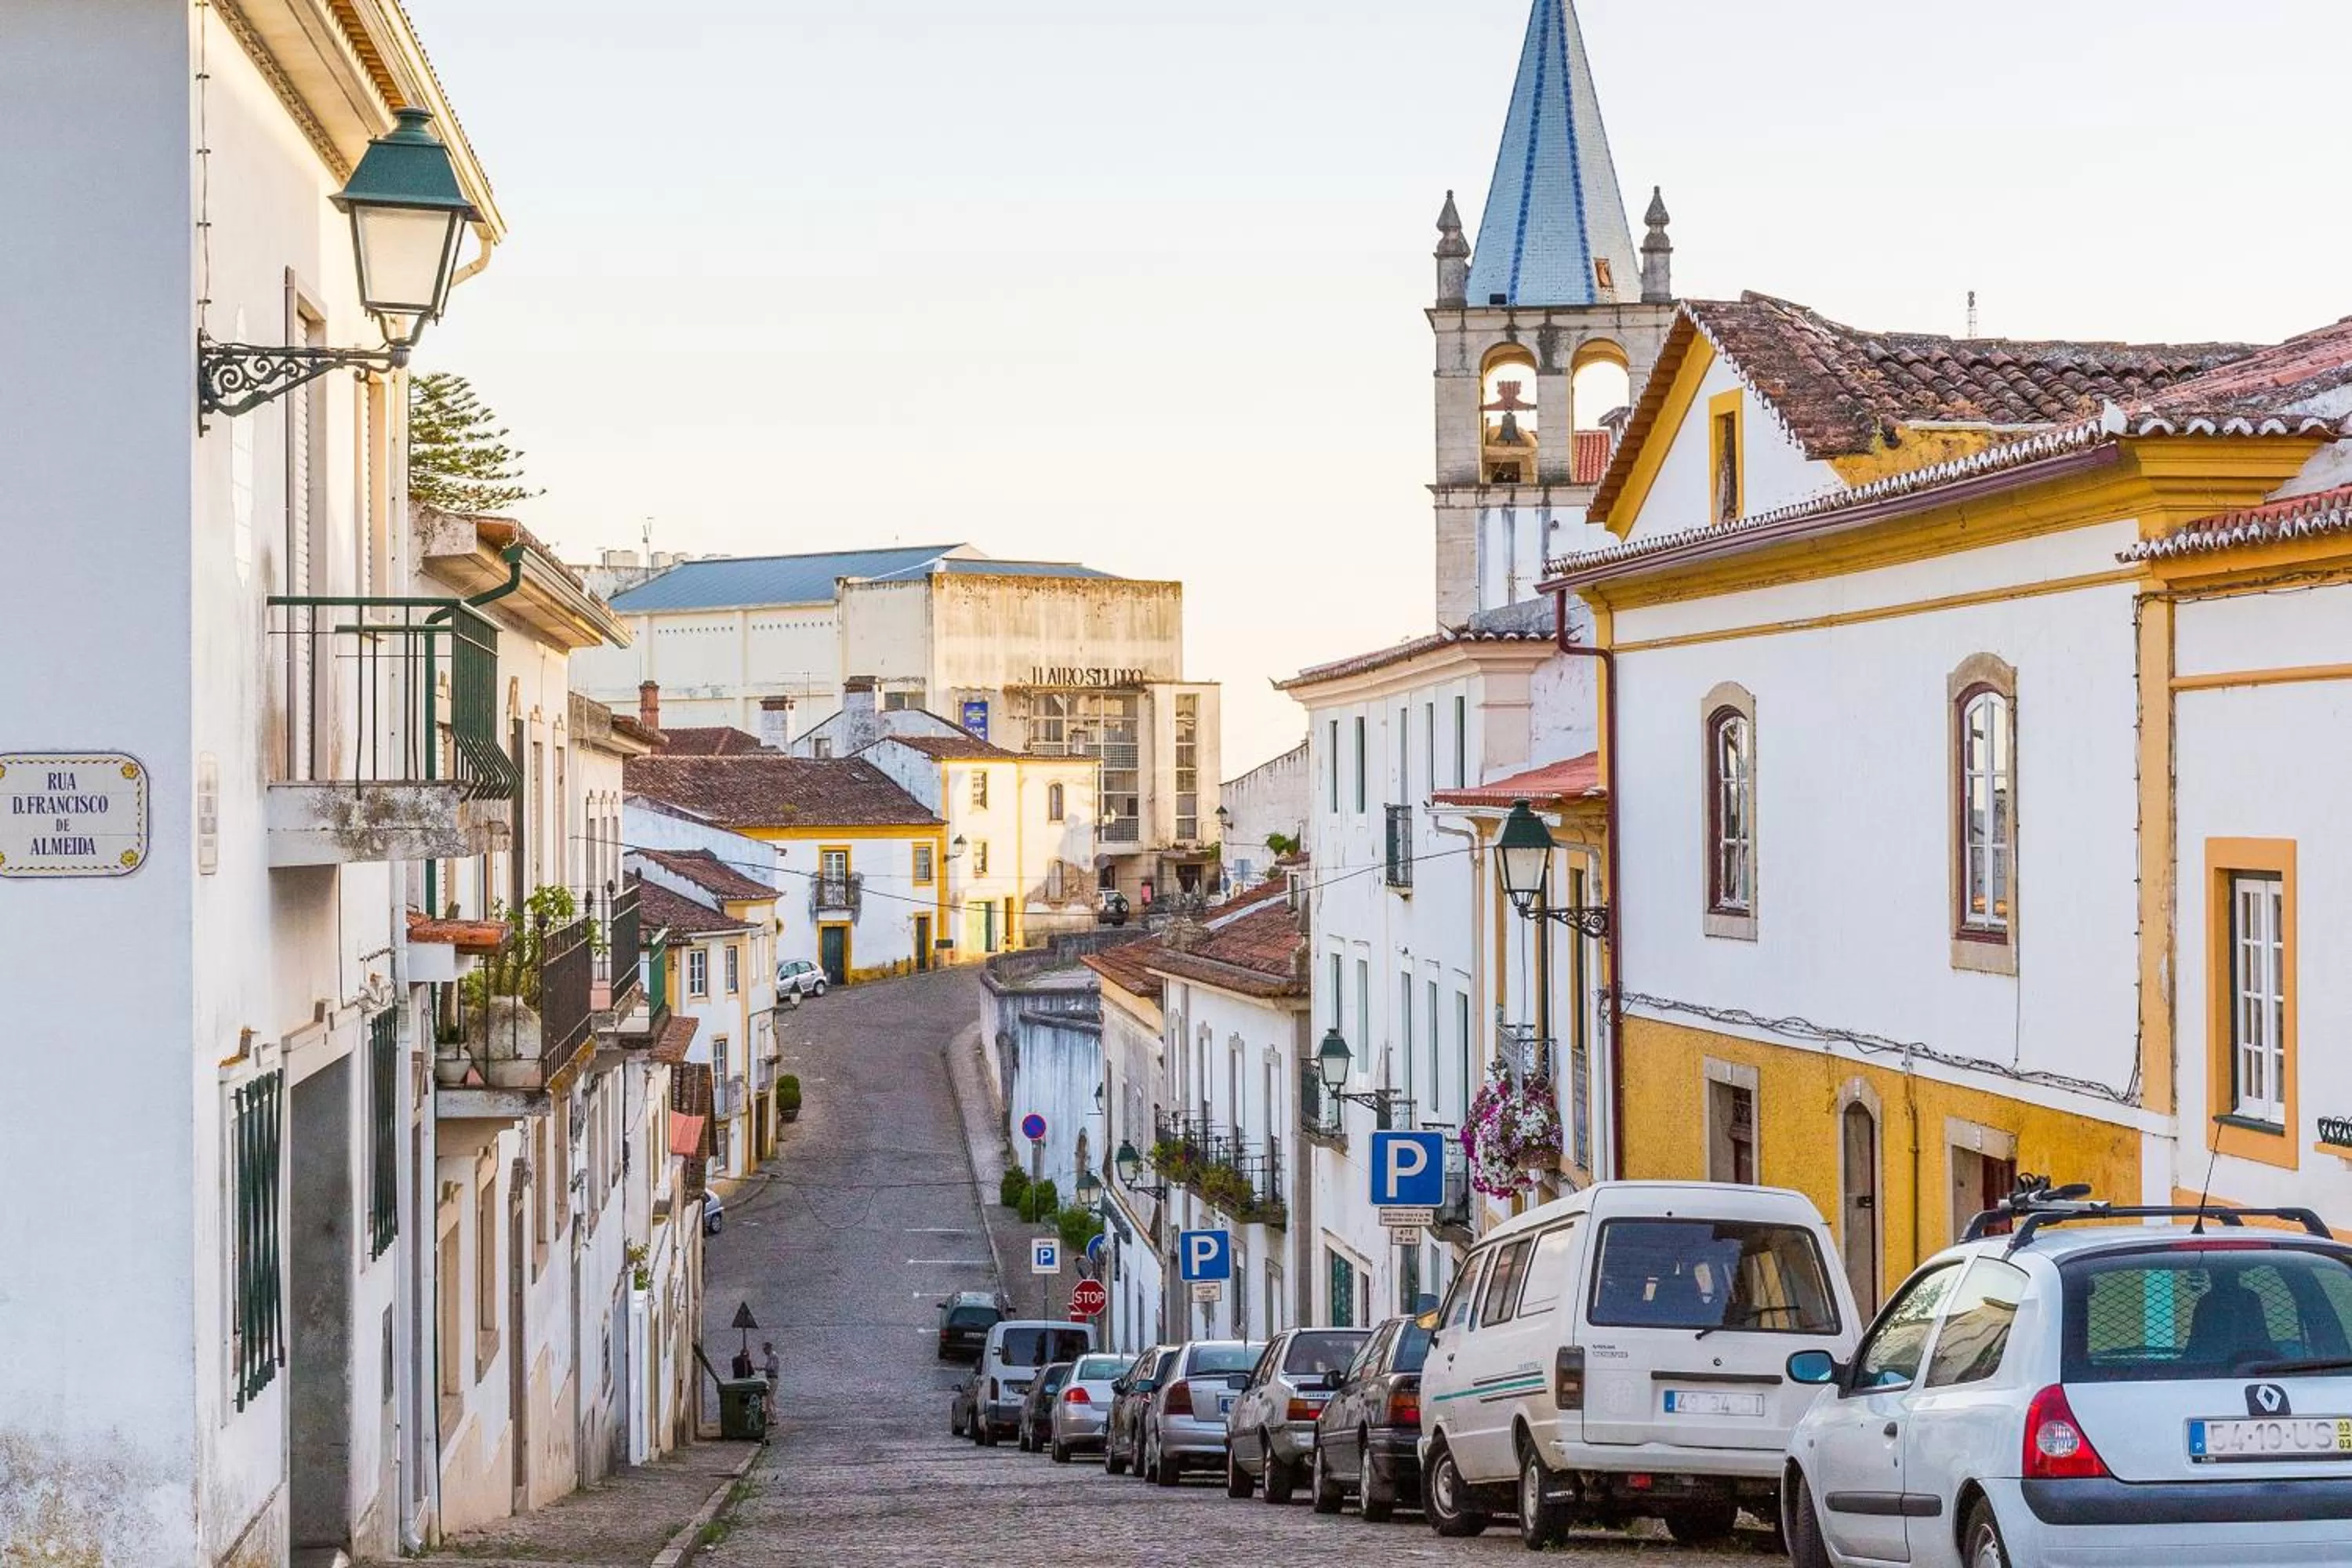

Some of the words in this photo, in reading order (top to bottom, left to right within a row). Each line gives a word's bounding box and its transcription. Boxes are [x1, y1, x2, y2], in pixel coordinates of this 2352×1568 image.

[48, 772, 76, 791] RUA
[56, 818, 71, 832] DE
[30, 837, 96, 855] ALMEIDA
[1386, 1139, 1428, 1198] P
[1040, 1249, 1051, 1265] P
[1190, 1236, 1219, 1276] P
[1075, 1291, 1105, 1304] STOP
